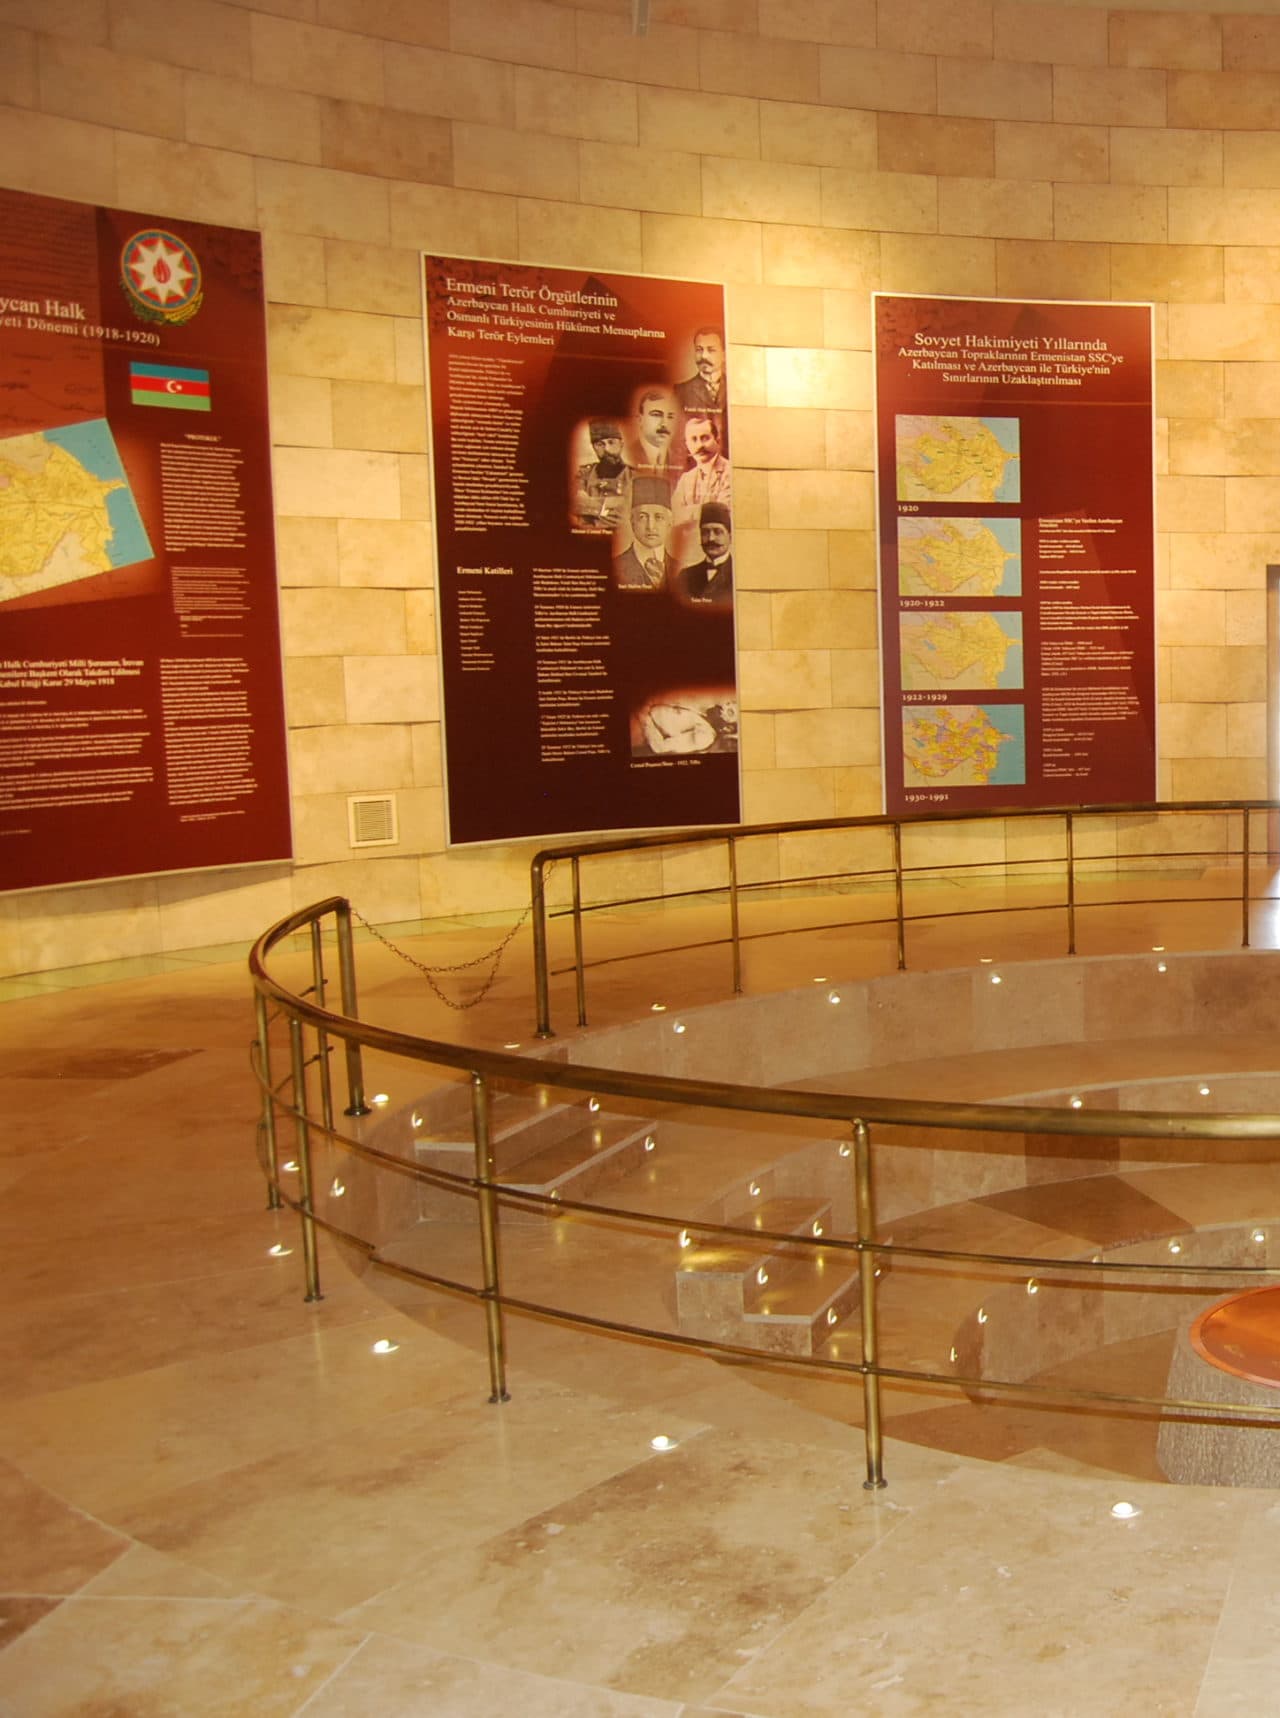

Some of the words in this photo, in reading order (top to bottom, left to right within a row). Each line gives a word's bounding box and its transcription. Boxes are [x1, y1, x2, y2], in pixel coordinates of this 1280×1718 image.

[447, 278, 496, 296] Ermeni
[499, 283, 535, 300] Terör
[539, 285, 618, 307] Örgütlerinin
[46, 300, 86, 320] Halk
[447, 296, 508, 312] Azerbaycan
[511, 302, 536, 314] Halk
[538, 305, 601, 320] Cumhuriyeti
[604, 312, 616, 321] ve
[27, 317, 78, 335] Dönemi
[82, 325, 160, 346] (1918-1920)
[447, 311, 490, 325] Osmanlı
[492, 314, 554, 330] Türkiyesinin
[556, 320, 600, 333] Hükümet
[602, 324, 666, 339] Mensuplarına
[447, 326, 475, 340] Karşı
[478, 329, 504, 341] Terör
[507, 332, 555, 345] Eylemleri
[914, 333, 961, 350] Sovyet
[966, 335, 1039, 351] Hakimiyeti
[1042, 337, 1108, 351] Yıllarında
[898, 347, 958, 360] Azerbaycan
[960, 348, 1028, 362] Topraklarının
[1030, 352, 1086, 363] Ermenistan
[1088, 353, 1124, 365] SSC'ye
[912, 359, 961, 371] Katılması
[963, 363, 976, 372] ve
[978, 361, 1037, 375] Azerbaycan
[1039, 363, 1052, 373] ile
[1054, 364, 1111, 376] Türkiye'nin
[942, 372, 999, 384] Sınırlarının
[1001, 374, 1082, 386] Uzaklaştırılması
[898, 505, 919, 513] 1920
[457, 566, 483, 575] Ermeni
[484, 567, 513, 575] Katilleri
[902, 694, 947, 702] 1922-1929
[905, 794, 949, 803] 1930-1991
